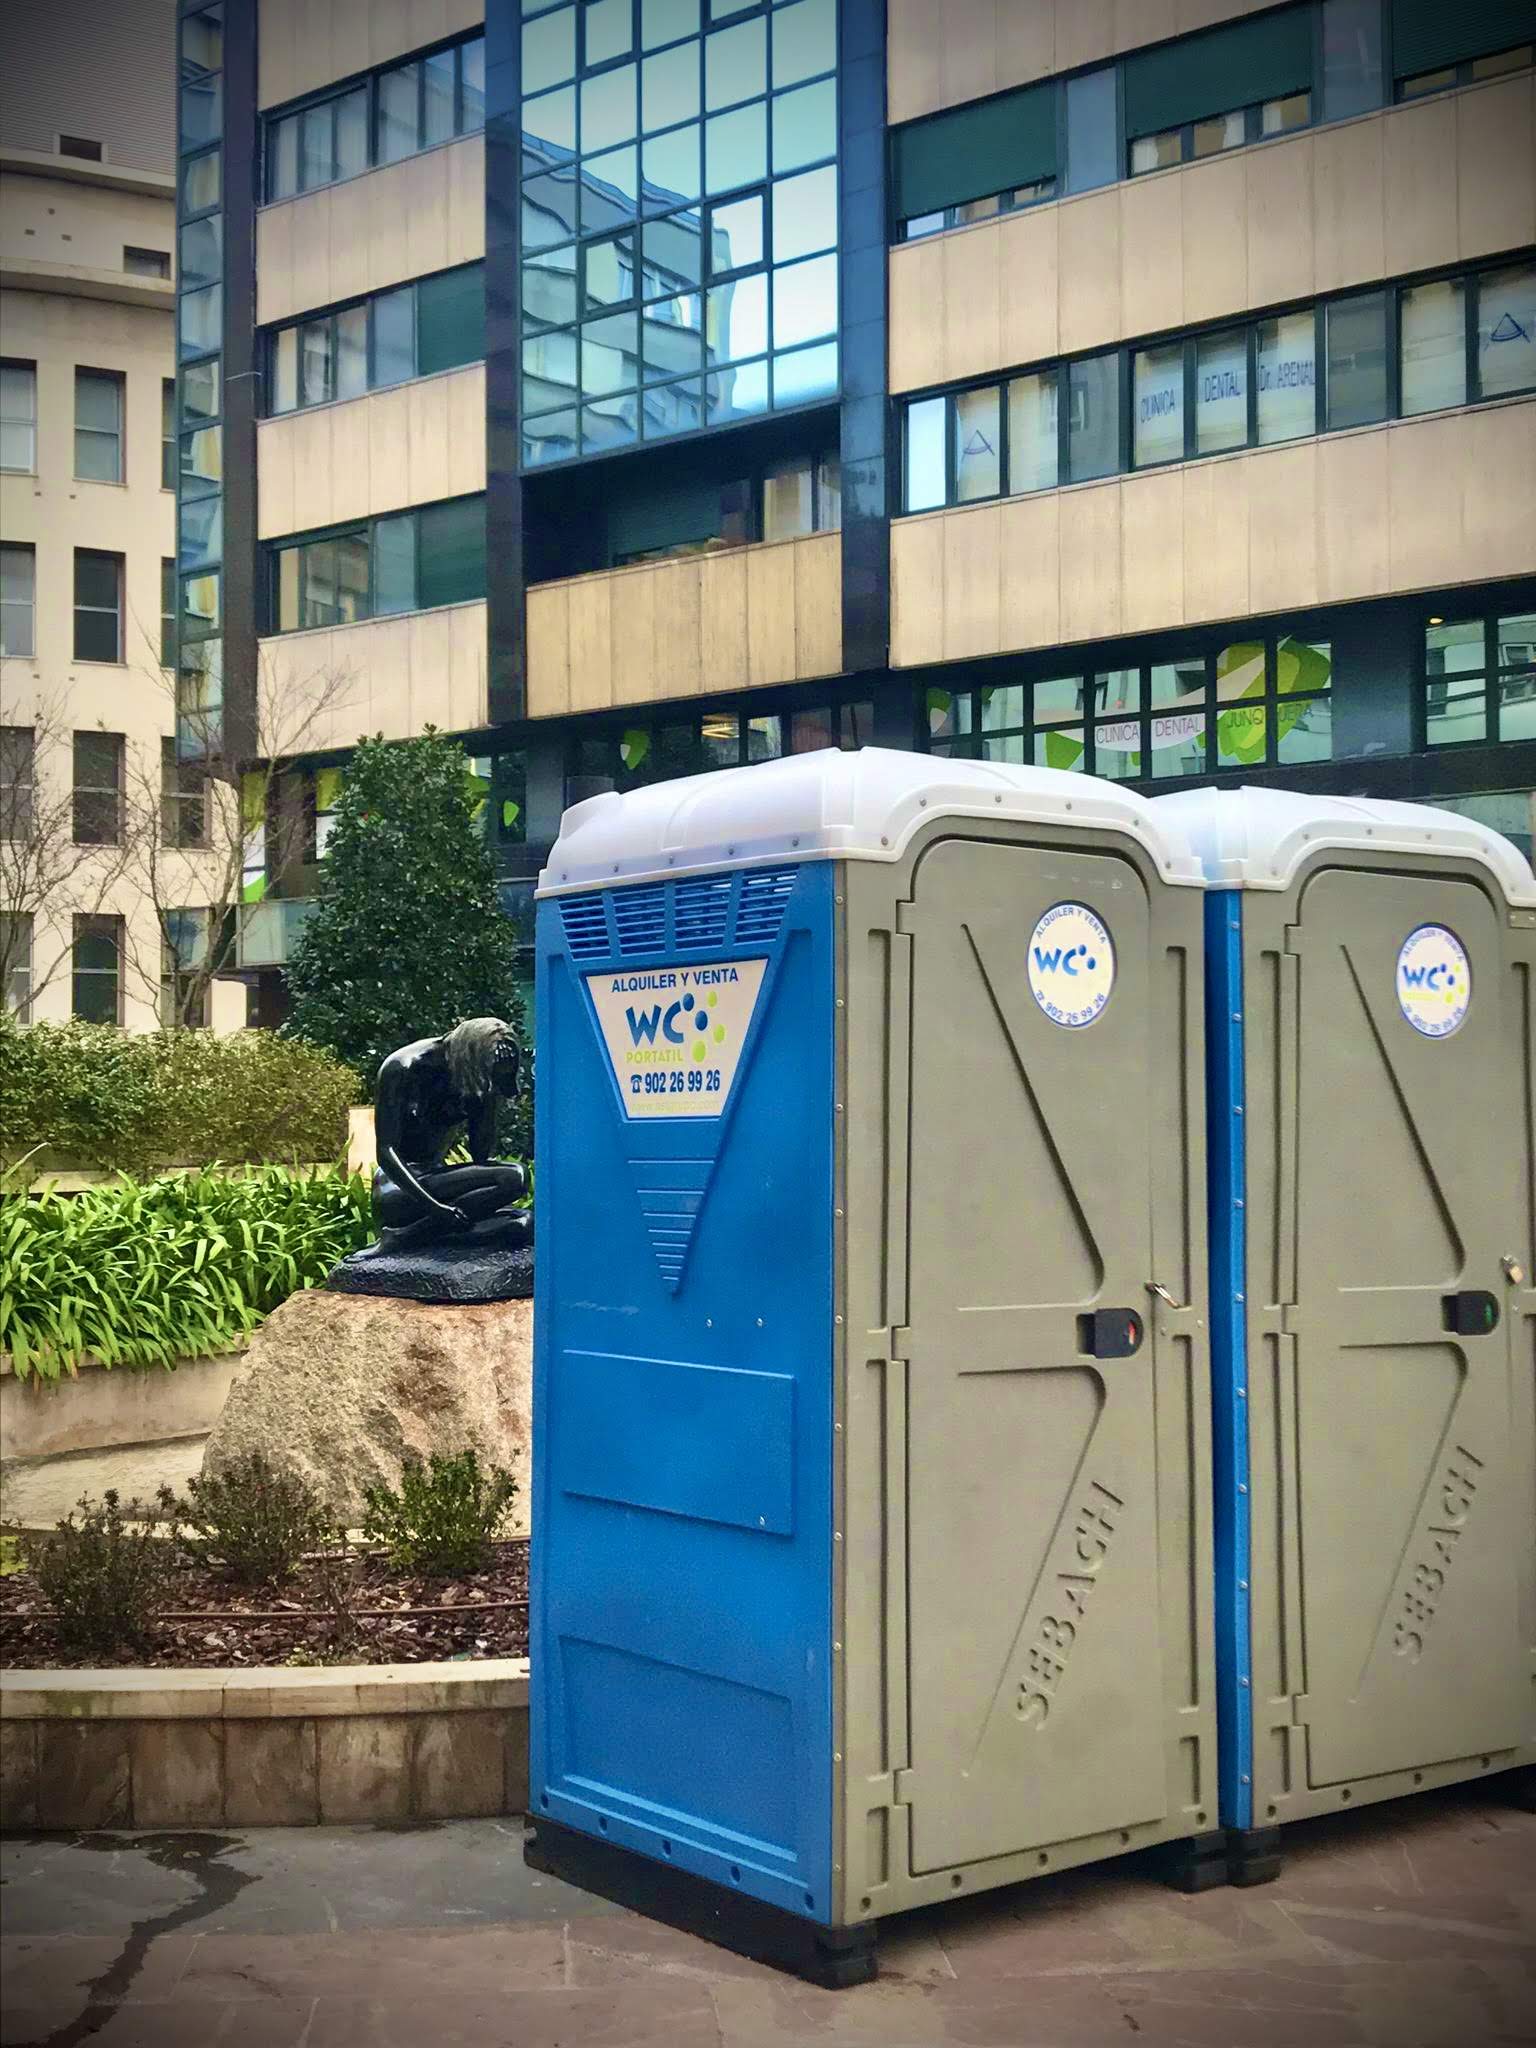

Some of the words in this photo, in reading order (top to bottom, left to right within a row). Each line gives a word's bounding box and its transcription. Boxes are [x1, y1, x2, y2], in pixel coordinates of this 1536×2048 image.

[1205, 371, 1241, 403] DENTAL
[1277, 361, 1316, 389] ARENAL
[1096, 724, 1140, 744] CLINICA
[1155, 716, 1201, 737] DENTAL
[1035, 906, 1074, 938] ALQUILER
[1077, 908, 1083, 917] Y
[1084, 913, 1106, 944] VENTA
[1033, 946, 1079, 977] WC
[611, 973, 677, 993] ALQUILER
[681, 972, 690, 987] Y
[693, 967, 739, 986] VENTA
[1402, 965, 1440, 991] WC
[625, 1000, 685, 1048] WC
[1045, 1001, 1064, 1021] 902
[1067, 1012, 1079, 1024] 26
[1080, 1006, 1093, 1020] 99
[626, 1048, 684, 1065] PORTATIL
[645, 1071, 666, 1094] 902
[669, 1071, 684, 1093] 26
[688, 1070, 702, 1092] 99
[706, 1069, 721, 1092] 26
